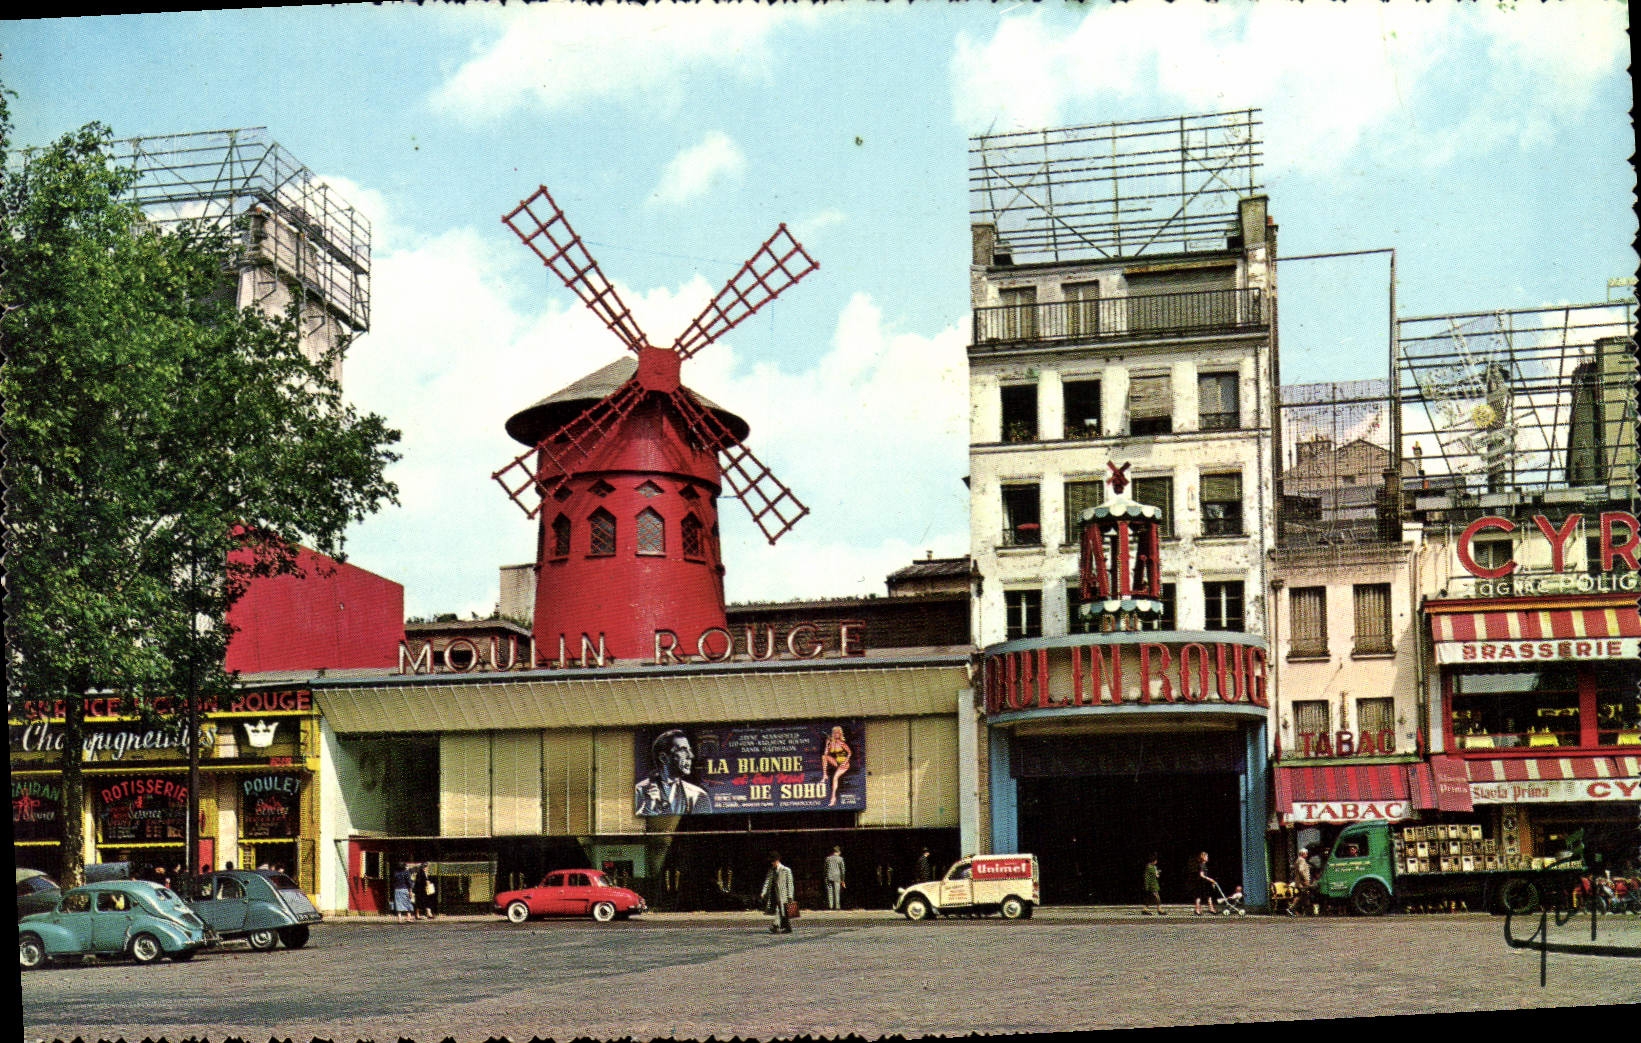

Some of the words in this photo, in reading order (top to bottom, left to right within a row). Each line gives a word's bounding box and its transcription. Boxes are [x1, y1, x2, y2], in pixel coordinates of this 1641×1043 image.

[1457, 511, 1640, 578] CYR
[397, 632, 609, 675] MOULIN
[653, 620, 867, 665] ROUGE
[1461, 641, 1622, 661] BRASSERIE
[231, 690, 312, 712] ROUGE
[707, 758, 730, 774] LA
[737, 756, 803, 774] BLONDE
[101, 779, 188, 803] ROTISSERIE
[243, 776, 302, 795] POULET
[750, 784, 772, 800] DE
[780, 783, 827, 799] SOHO
[1586, 781, 1639, 798] CY
[1301, 802, 1403, 820] TABAC
[976, 862, 1027, 875] Unimel
